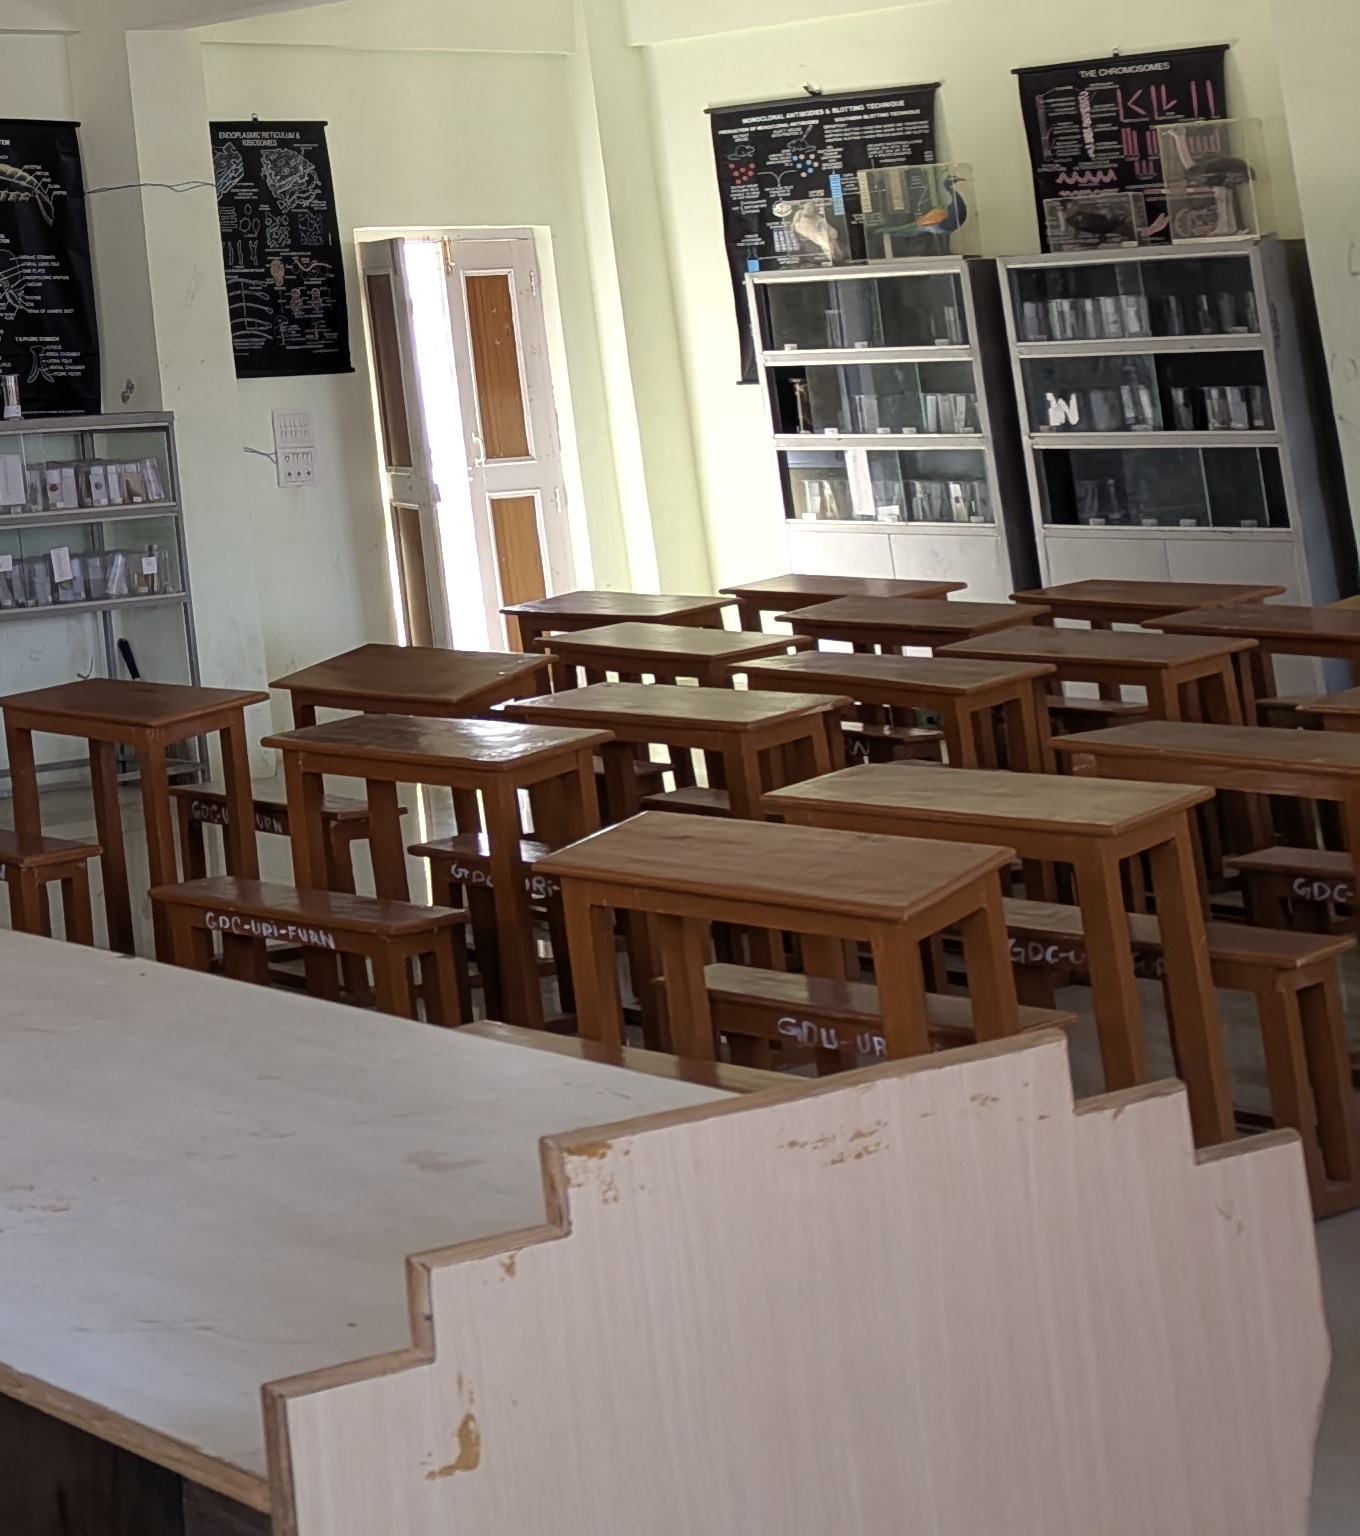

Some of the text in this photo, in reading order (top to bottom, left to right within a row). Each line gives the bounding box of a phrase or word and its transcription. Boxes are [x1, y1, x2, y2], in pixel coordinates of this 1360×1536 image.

[1079, 62, 1170, 78] THE CHROMOSOMES
[742, 113, 785, 124] MONOCLONAL
[786, 109, 824, 120] ANTIBODIES
[832, 104, 865, 114] BLOTTING
[866, 100, 905, 110] TECHNIQUE
